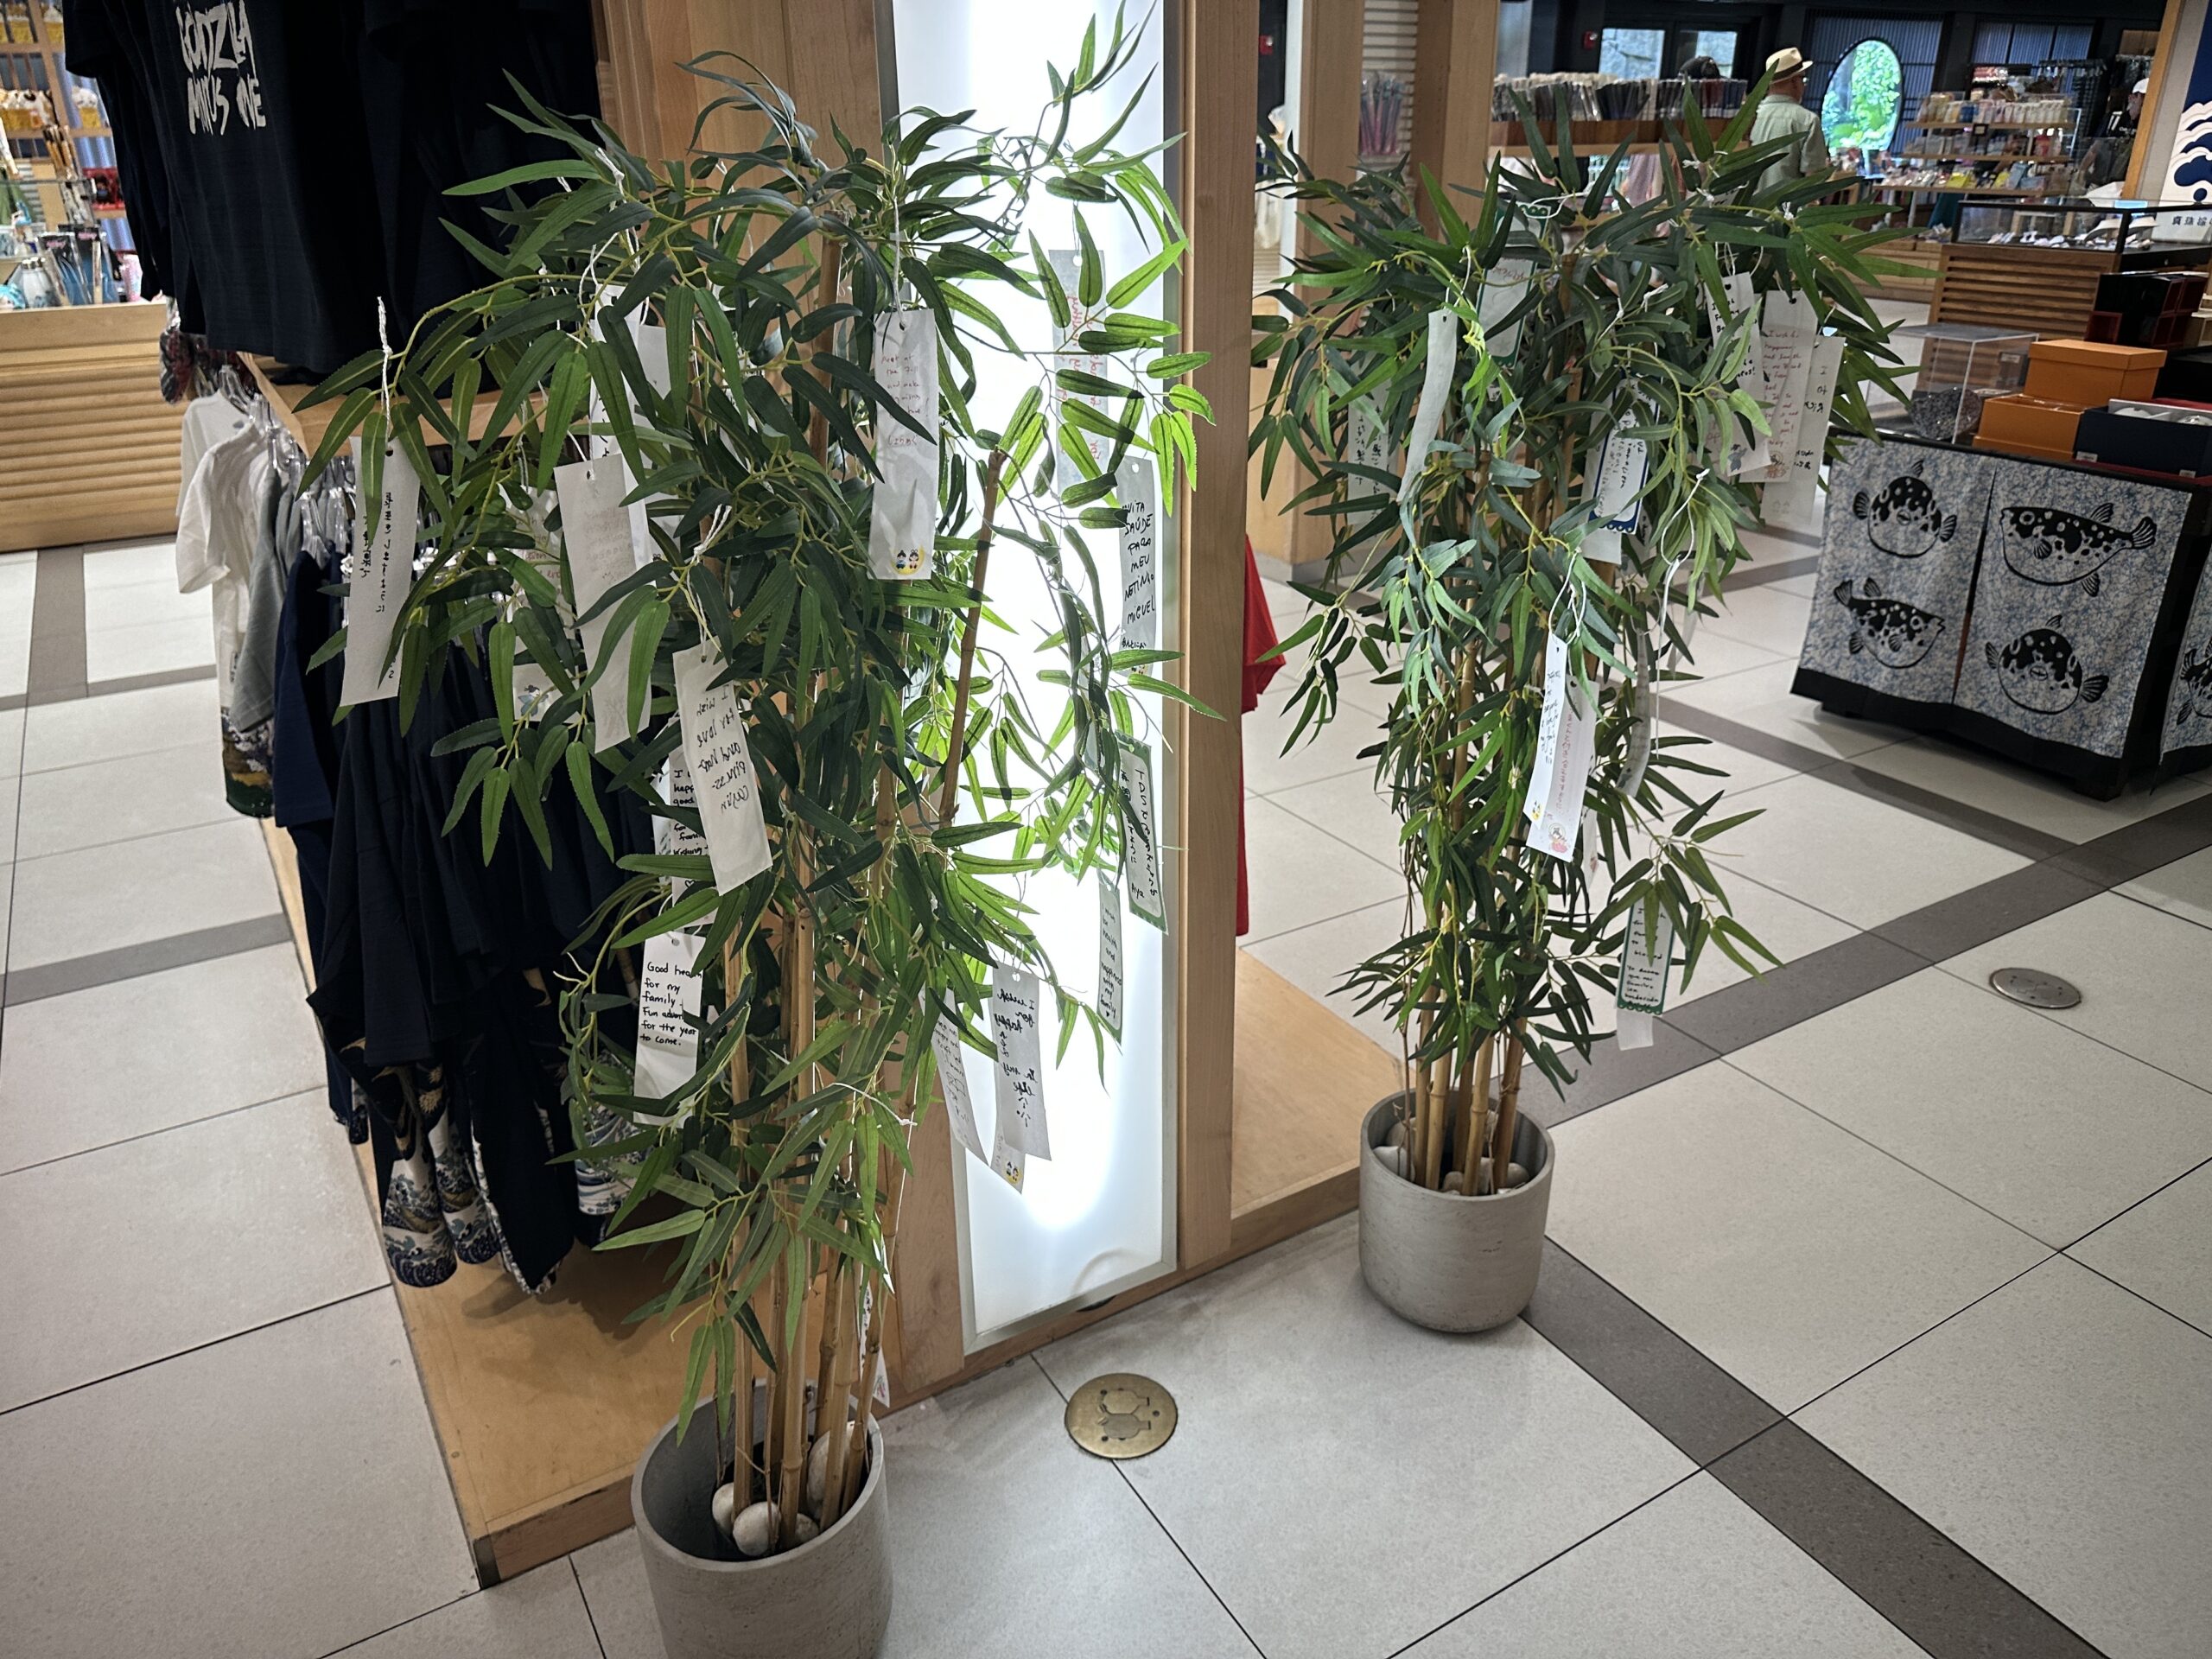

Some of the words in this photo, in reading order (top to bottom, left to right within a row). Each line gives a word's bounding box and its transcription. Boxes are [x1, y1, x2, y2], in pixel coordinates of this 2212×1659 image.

[188, 74, 230, 136] MINUS
[237, 74, 266, 130] ONE
[1127, 537, 1152, 556] PARA
[1130, 554, 1150, 573] MEU
[673, 769, 683, 778] I
[673, 798, 695, 807] good
[647, 961, 669, 973] Good
[675, 965, 702, 979] heah
[645, 977, 659, 988] for
[667, 983, 680, 995] my
[643, 1007, 658, 1017] Fun
[641, 1020, 656, 1030] for
[659, 1023, 676, 1033] the
[680, 1027, 696, 1037] year
